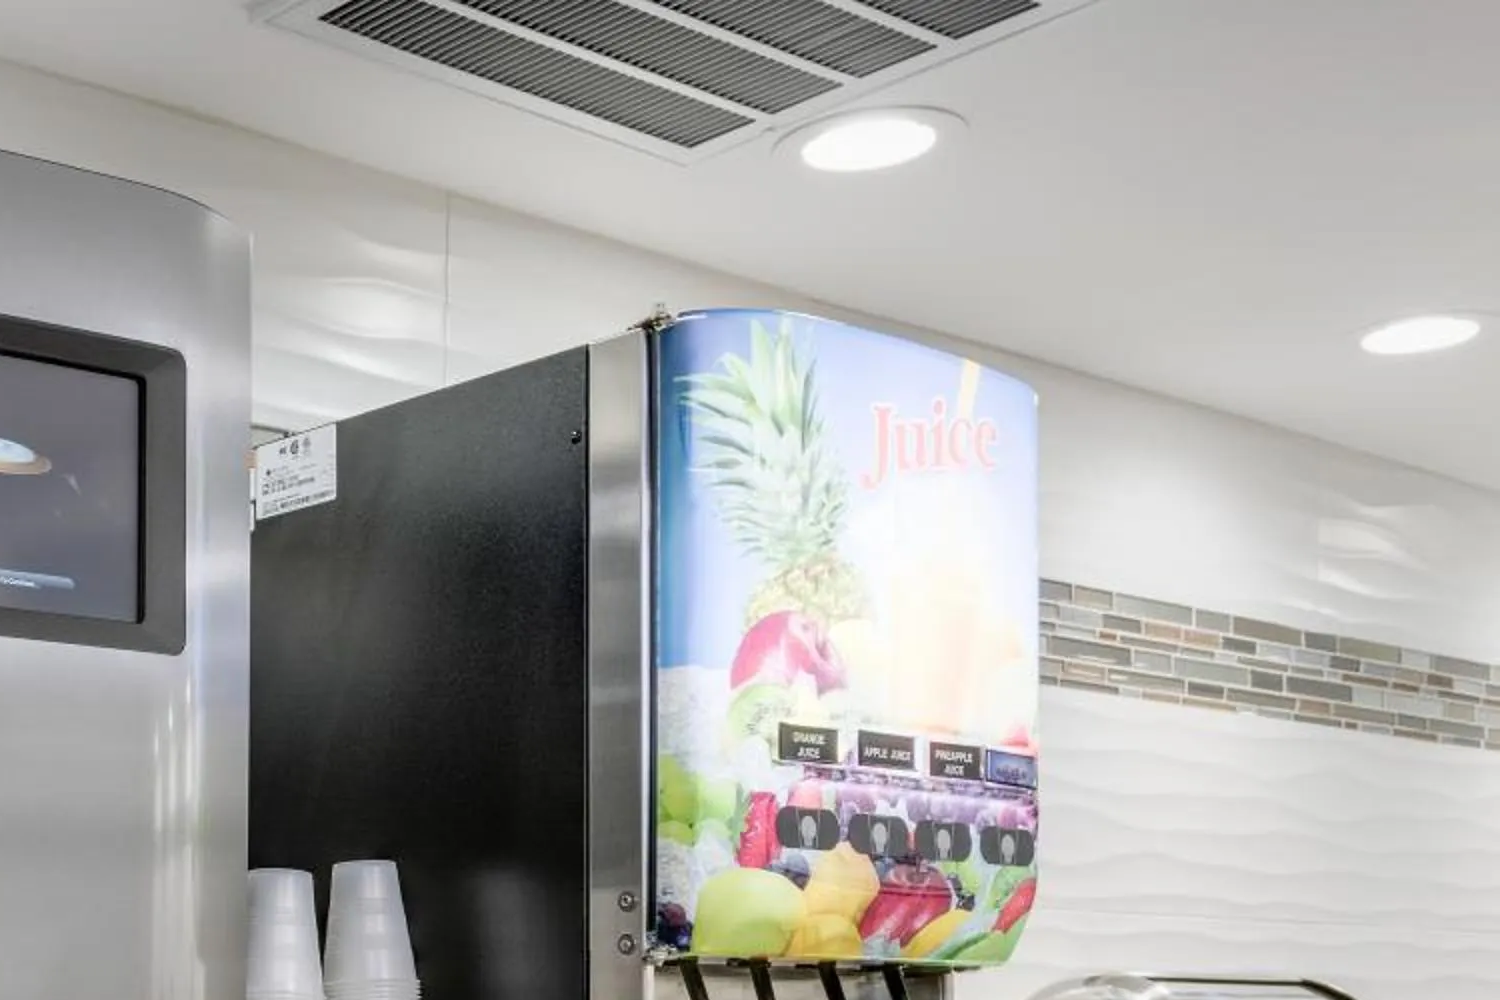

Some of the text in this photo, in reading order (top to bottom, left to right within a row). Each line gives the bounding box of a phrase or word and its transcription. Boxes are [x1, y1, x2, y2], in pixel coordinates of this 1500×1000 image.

[860, 399, 997, 491] Juice
[797, 746, 820, 758] JUICE
[864, 746, 911, 761] APPLE JUICE
[935, 749, 973, 763] PINEAPPLE
[944, 764, 965, 776] JUICE
